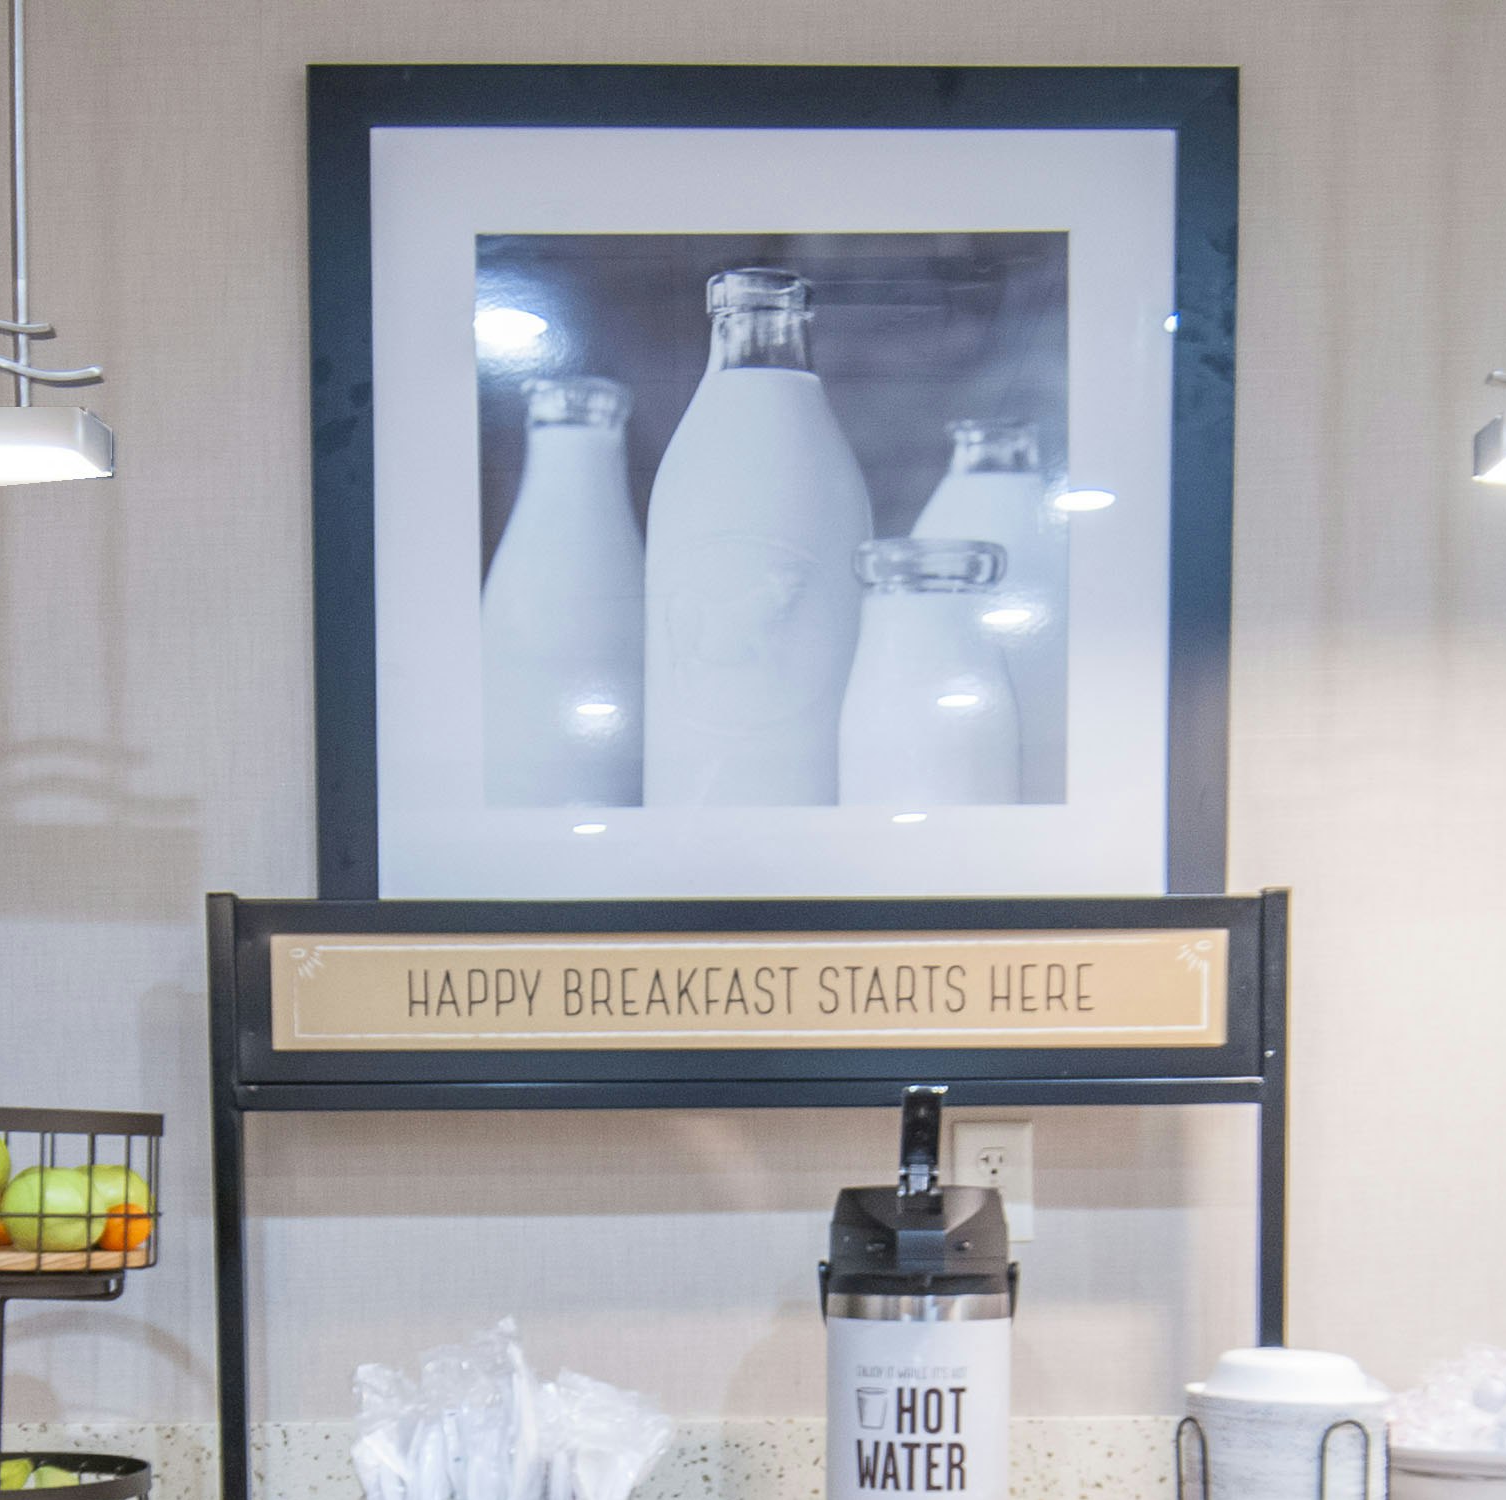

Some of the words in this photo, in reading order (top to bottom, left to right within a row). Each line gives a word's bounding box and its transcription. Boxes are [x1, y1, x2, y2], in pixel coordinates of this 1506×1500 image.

[406, 967, 542, 1018] HAPPY
[562, 965, 800, 1018] BREAKFAST
[817, 963, 967, 1015] STARTS
[989, 962, 1096, 1014] HERE
[896, 1387, 967, 1434] HOT
[856, 1439, 967, 1491] WATER
